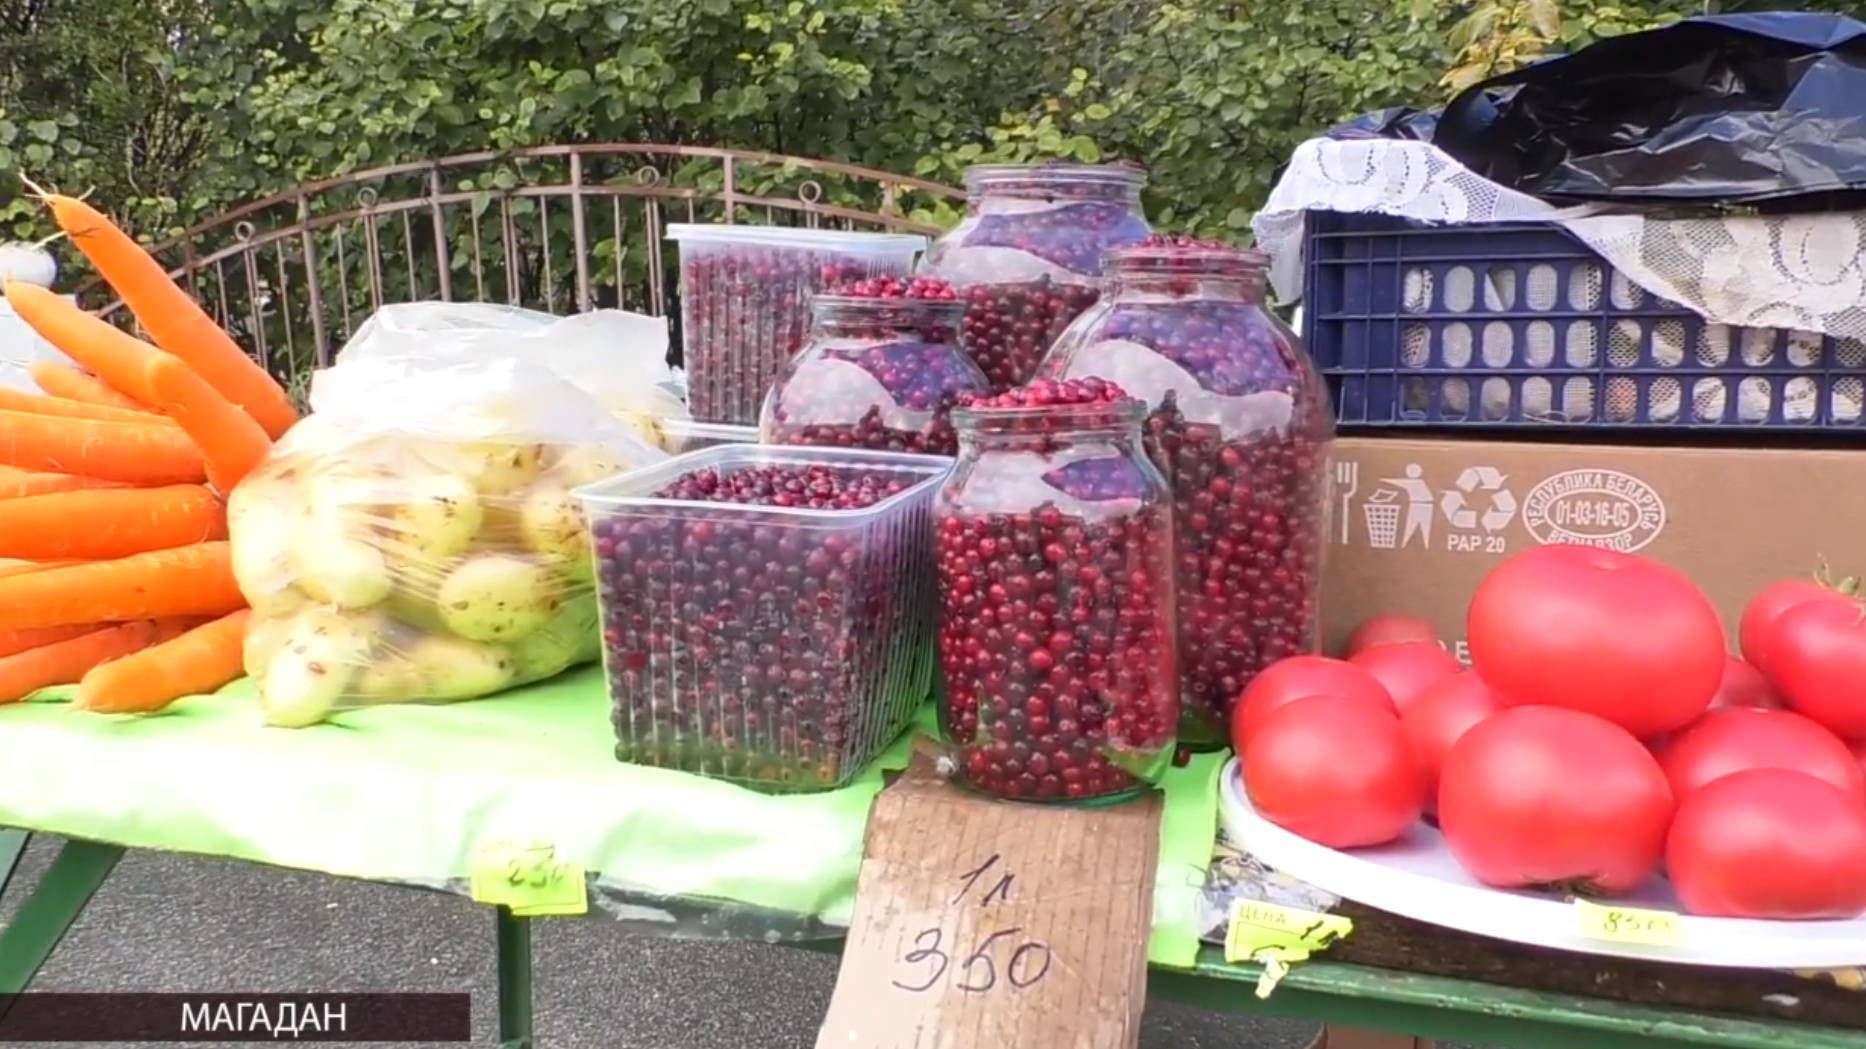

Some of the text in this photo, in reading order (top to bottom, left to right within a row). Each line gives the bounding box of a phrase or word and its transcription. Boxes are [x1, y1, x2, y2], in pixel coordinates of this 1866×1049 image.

[1528, 472, 1660, 530] РЕСПУБЛИКА БЕЛАРУСЬ
[1555, 500, 1631, 527] 01-03-16-05
[1448, 535, 1505, 553] PAP 20
[1239, 904, 1286, 925] ЦЕНА
[892, 928, 1051, 991] 350
